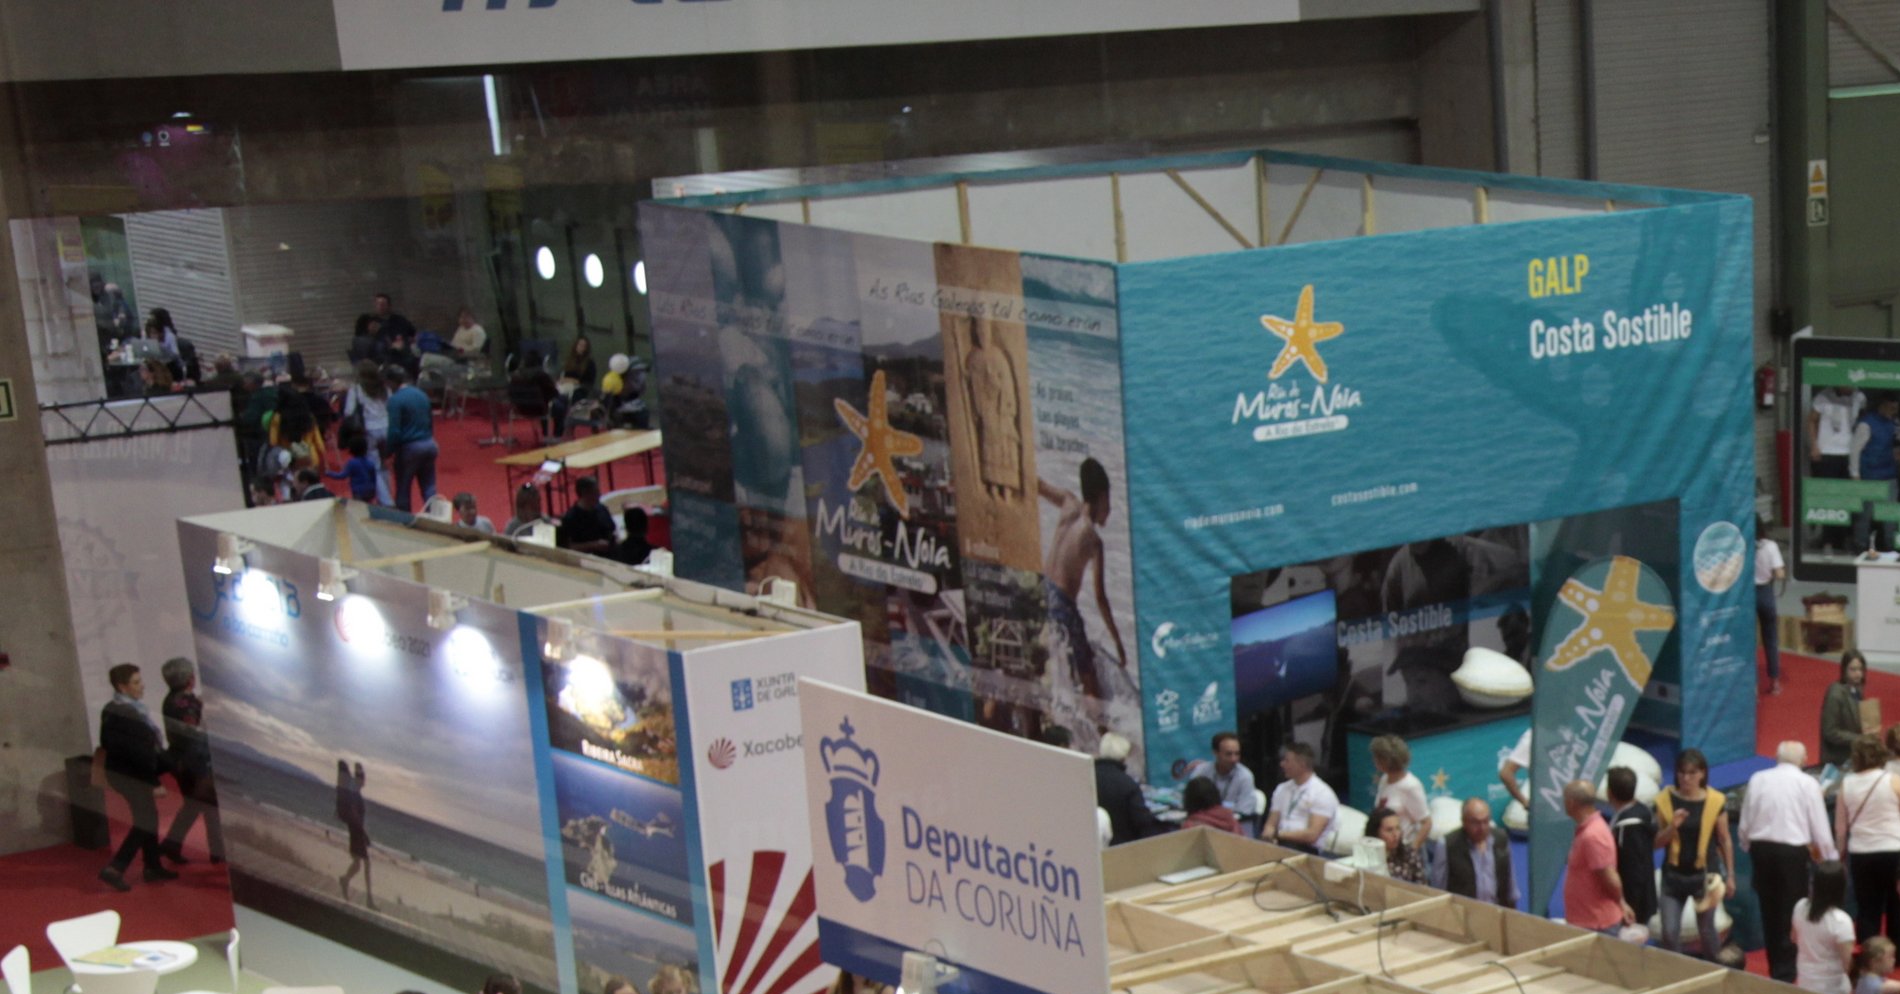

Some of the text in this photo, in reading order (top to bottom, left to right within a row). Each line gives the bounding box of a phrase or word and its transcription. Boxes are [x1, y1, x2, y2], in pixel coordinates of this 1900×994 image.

[1528, 254, 1590, 298] GALP
[869, 279, 888, 299] As
[992, 299, 1013, 317] tal
[1019, 310, 1063, 329] como
[1067, 317, 1101, 332] eran
[1530, 302, 1692, 360] Costa Sostible
[1232, 384, 1362, 424] Muros-Noia
[1331, 482, 1418, 506] costasostible.com
[1807, 508, 1849, 522] AGRO
[815, 499, 952, 568] Muros-Noia
[1337, 604, 1452, 647] Costa Sostible
[1540, 667, 1616, 812] Muros-Noia
[902, 805, 1080, 900] Deputación
[905, 861, 1085, 958] DA CORUÑA
